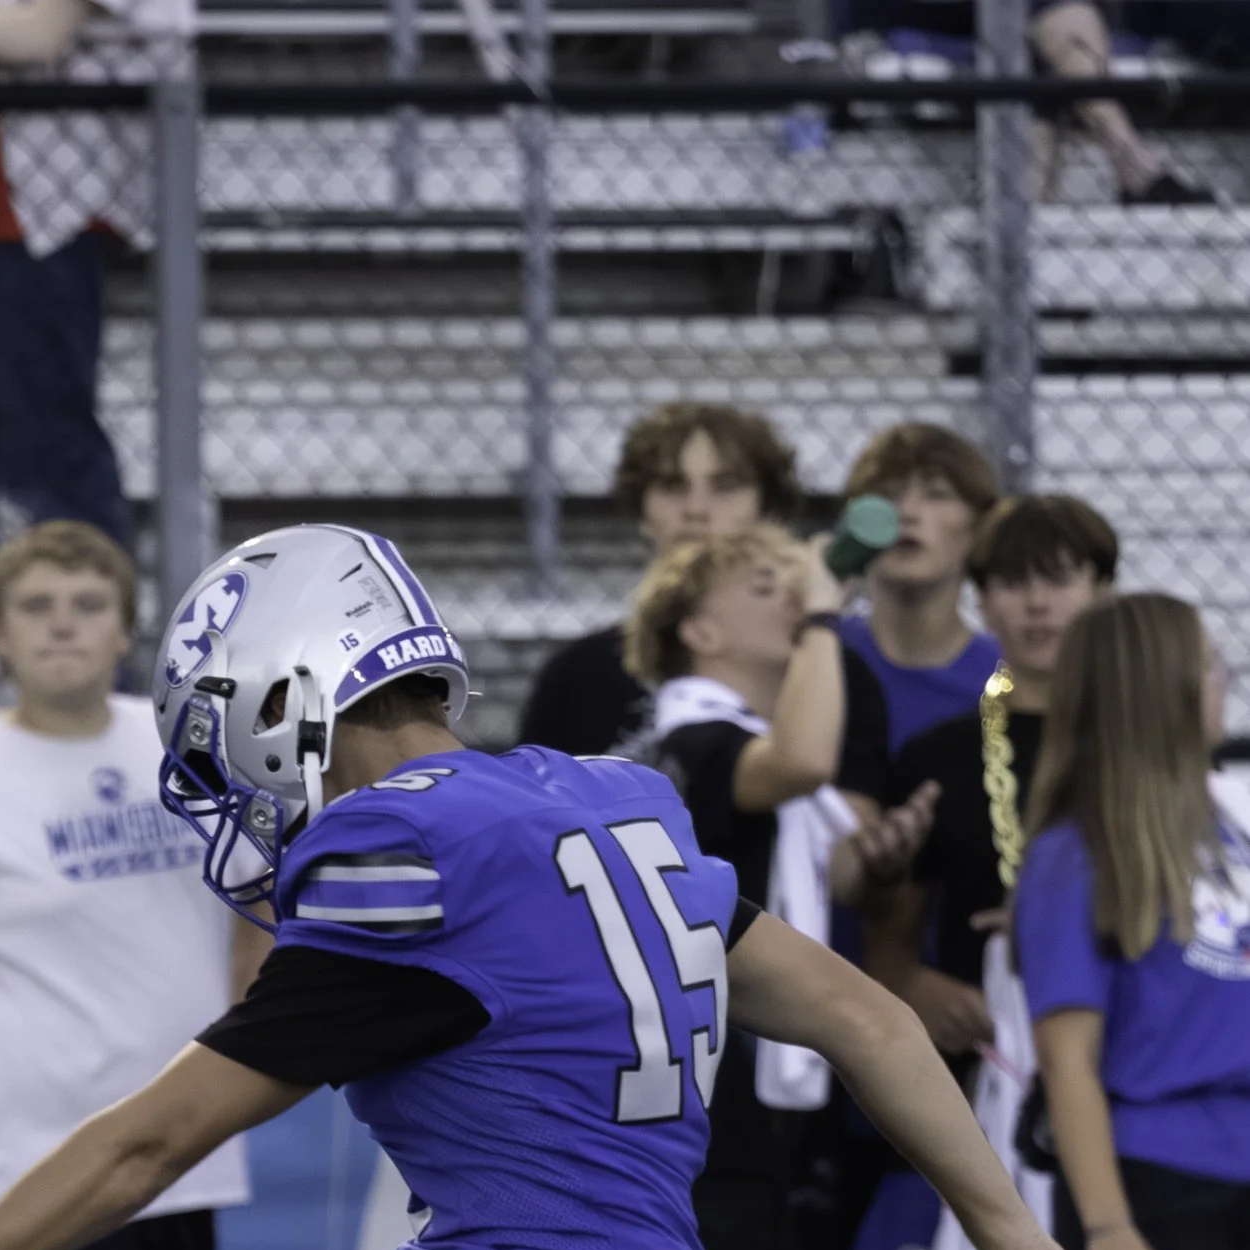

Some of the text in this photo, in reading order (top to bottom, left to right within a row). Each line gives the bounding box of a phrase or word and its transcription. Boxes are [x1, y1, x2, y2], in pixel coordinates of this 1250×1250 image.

[338, 632, 361, 652] 15
[376, 634, 448, 671] HARD
[553, 817, 729, 1127] 15
